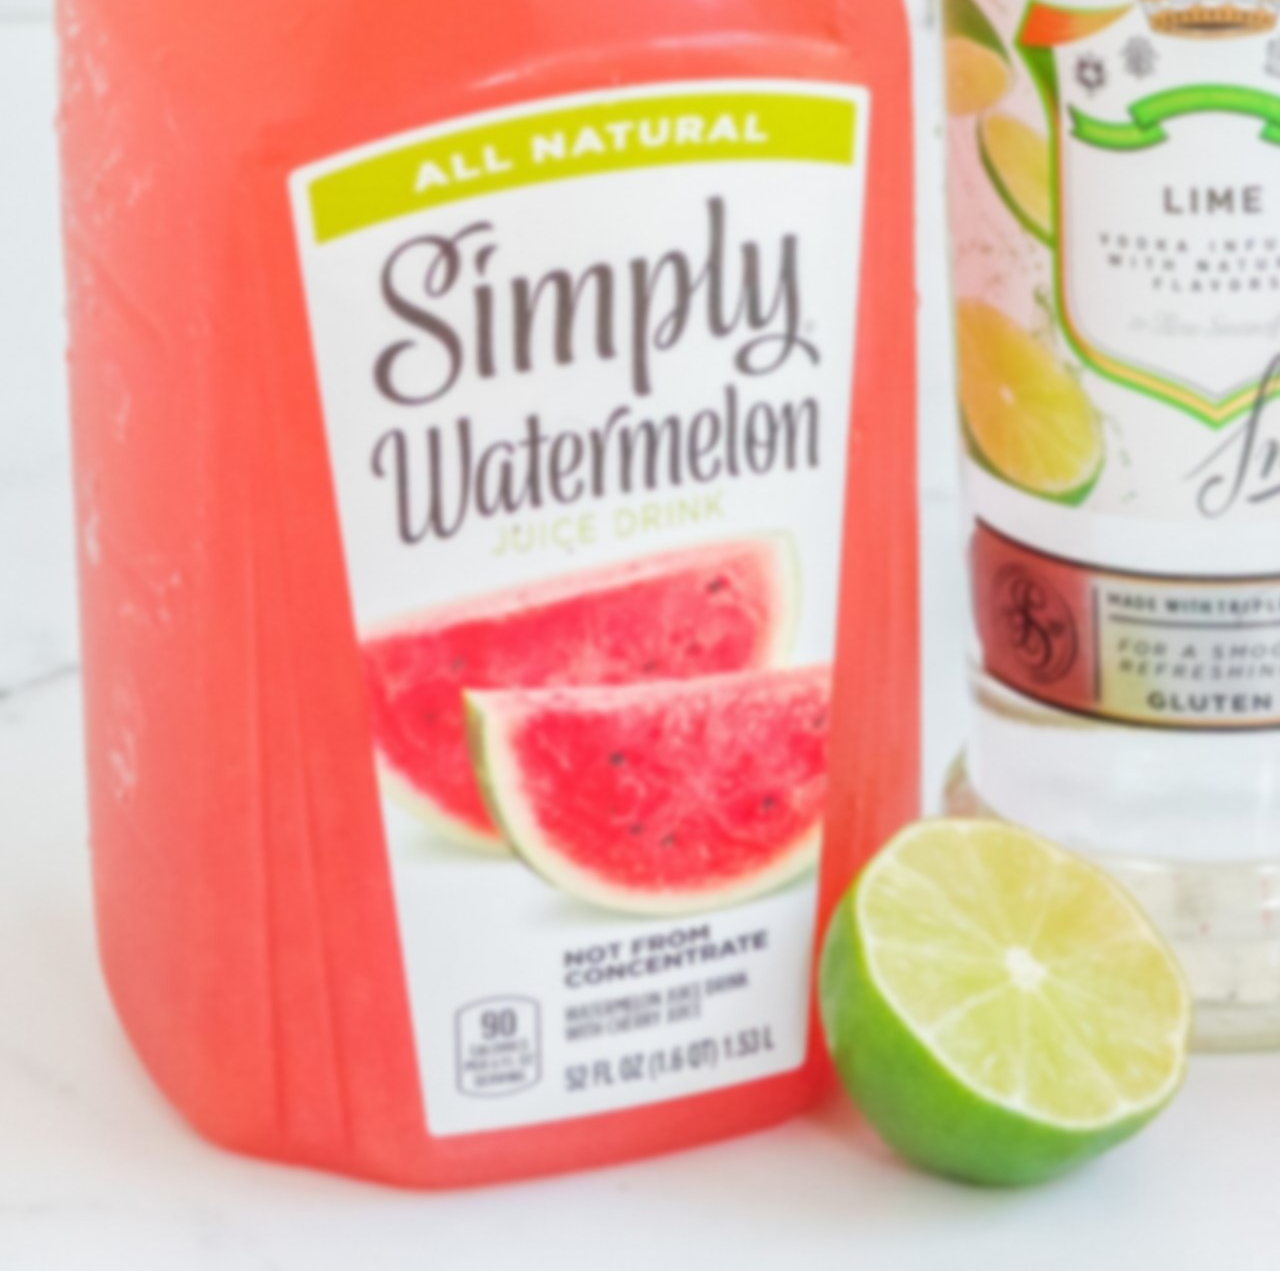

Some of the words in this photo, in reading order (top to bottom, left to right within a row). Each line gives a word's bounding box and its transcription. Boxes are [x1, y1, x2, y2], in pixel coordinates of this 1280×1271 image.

[413, 146, 512, 194] ALL
[530, 112, 770, 165] NATURAL
[1162, 184, 1265, 216] LIME
[1099, 231, 1189, 254] VODKA
[1107, 253, 1177, 272] WITH
[372, 194, 821, 407] Simply
[1152, 276, 1280, 294] FLAVORS
[371, 382, 820, 546] Watermelon
[490, 511, 598, 558] JUICE
[611, 489, 726, 541] DRINK
[1107, 593, 1157, 612] MADE
[1117, 637, 1168, 658] FOR
[1181, 642, 1198, 660] A
[1146, 689, 1274, 714] GLUTEN
[563, 941, 622, 970] NOT
[630, 923, 711, 956] FROM
[563, 928, 769, 989] CONCENTRATE
[479, 1007, 518, 1041] 90
[564, 1063, 589, 1093] 52
[593, 1058, 614, 1086] FL
[619, 1051, 645, 1082] OZ
[763, 1023, 775, 1051] L
